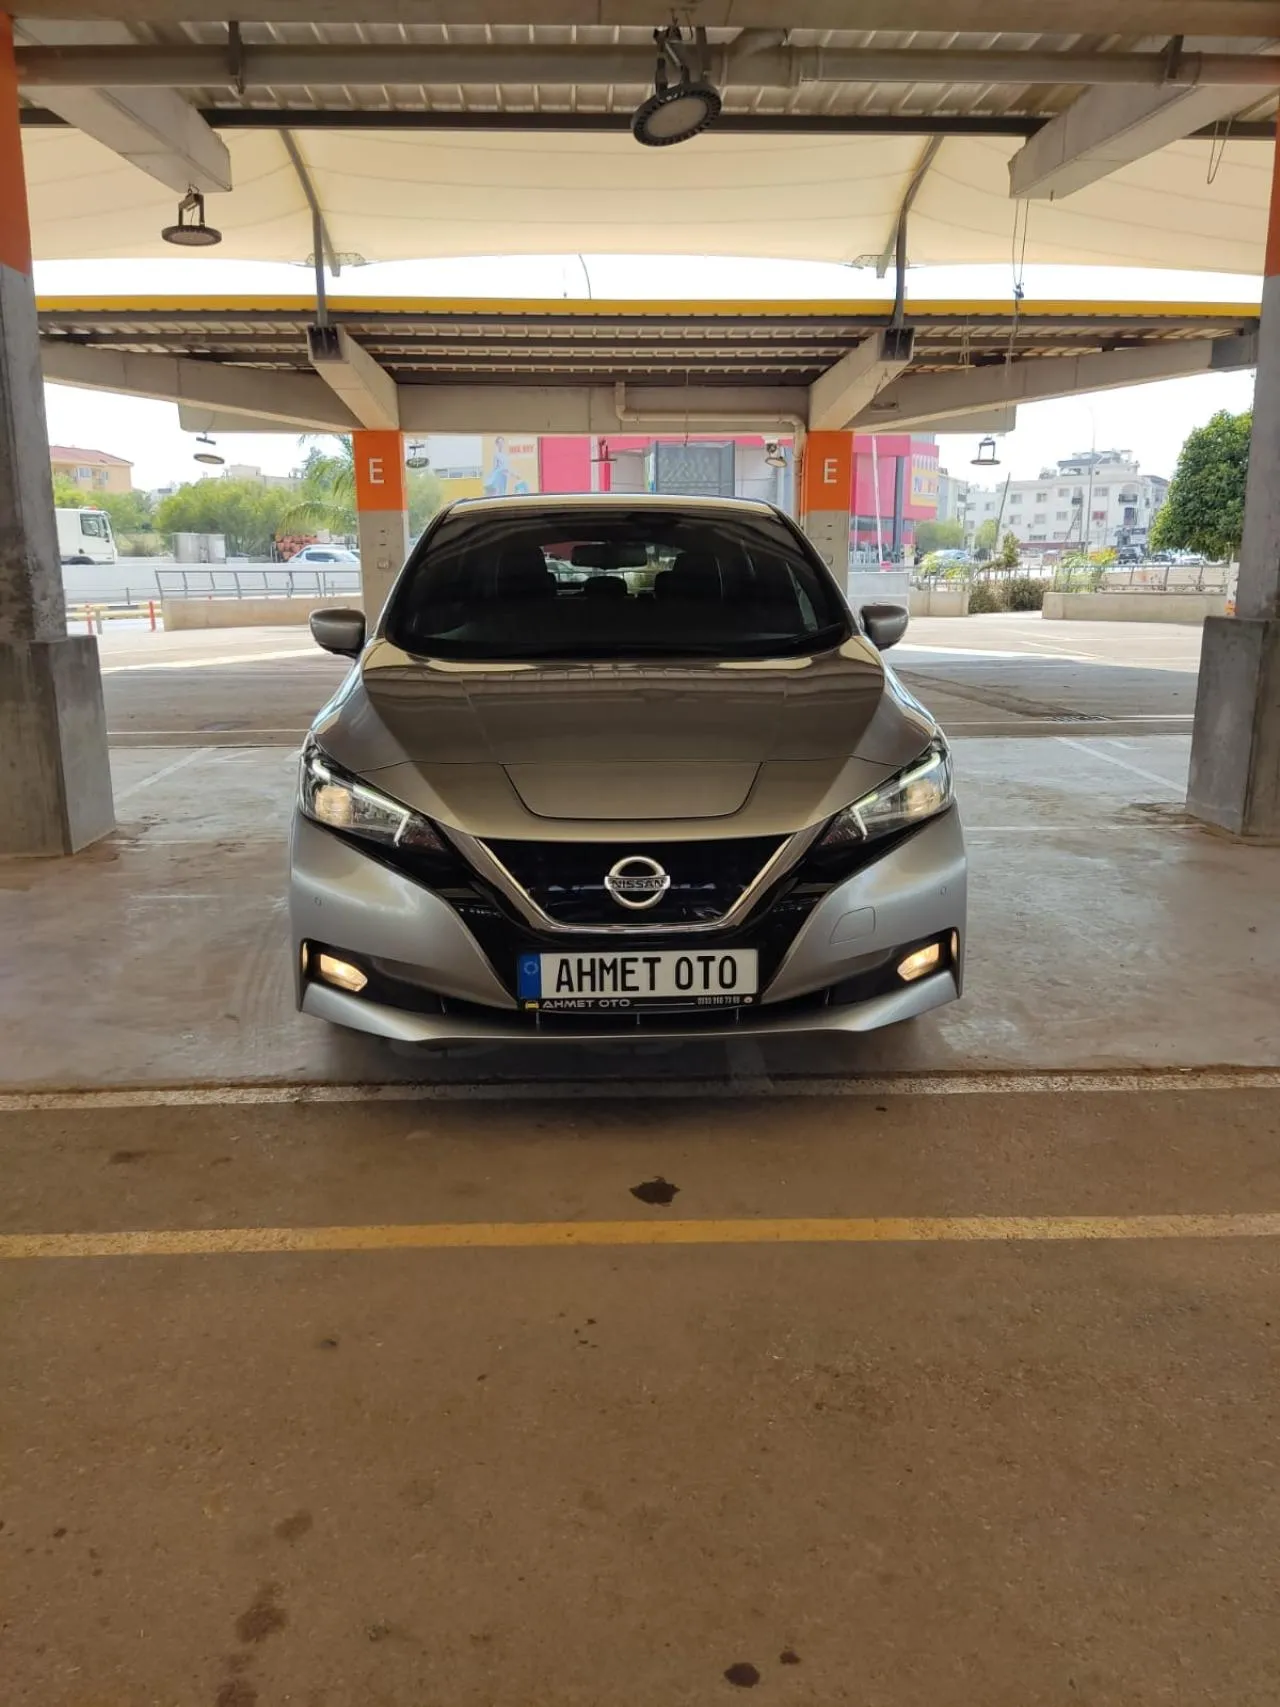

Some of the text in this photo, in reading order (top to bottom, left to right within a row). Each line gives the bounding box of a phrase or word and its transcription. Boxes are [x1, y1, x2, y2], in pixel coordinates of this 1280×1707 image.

[369, 458, 385, 484] E
[824, 458, 838, 484] E
[611, 879, 663, 889] NISSAN
[555, 955, 737, 993] AHMET OTO
[542, 999, 595, 1009] AHMET
[598, 999, 631, 1008] OTO
